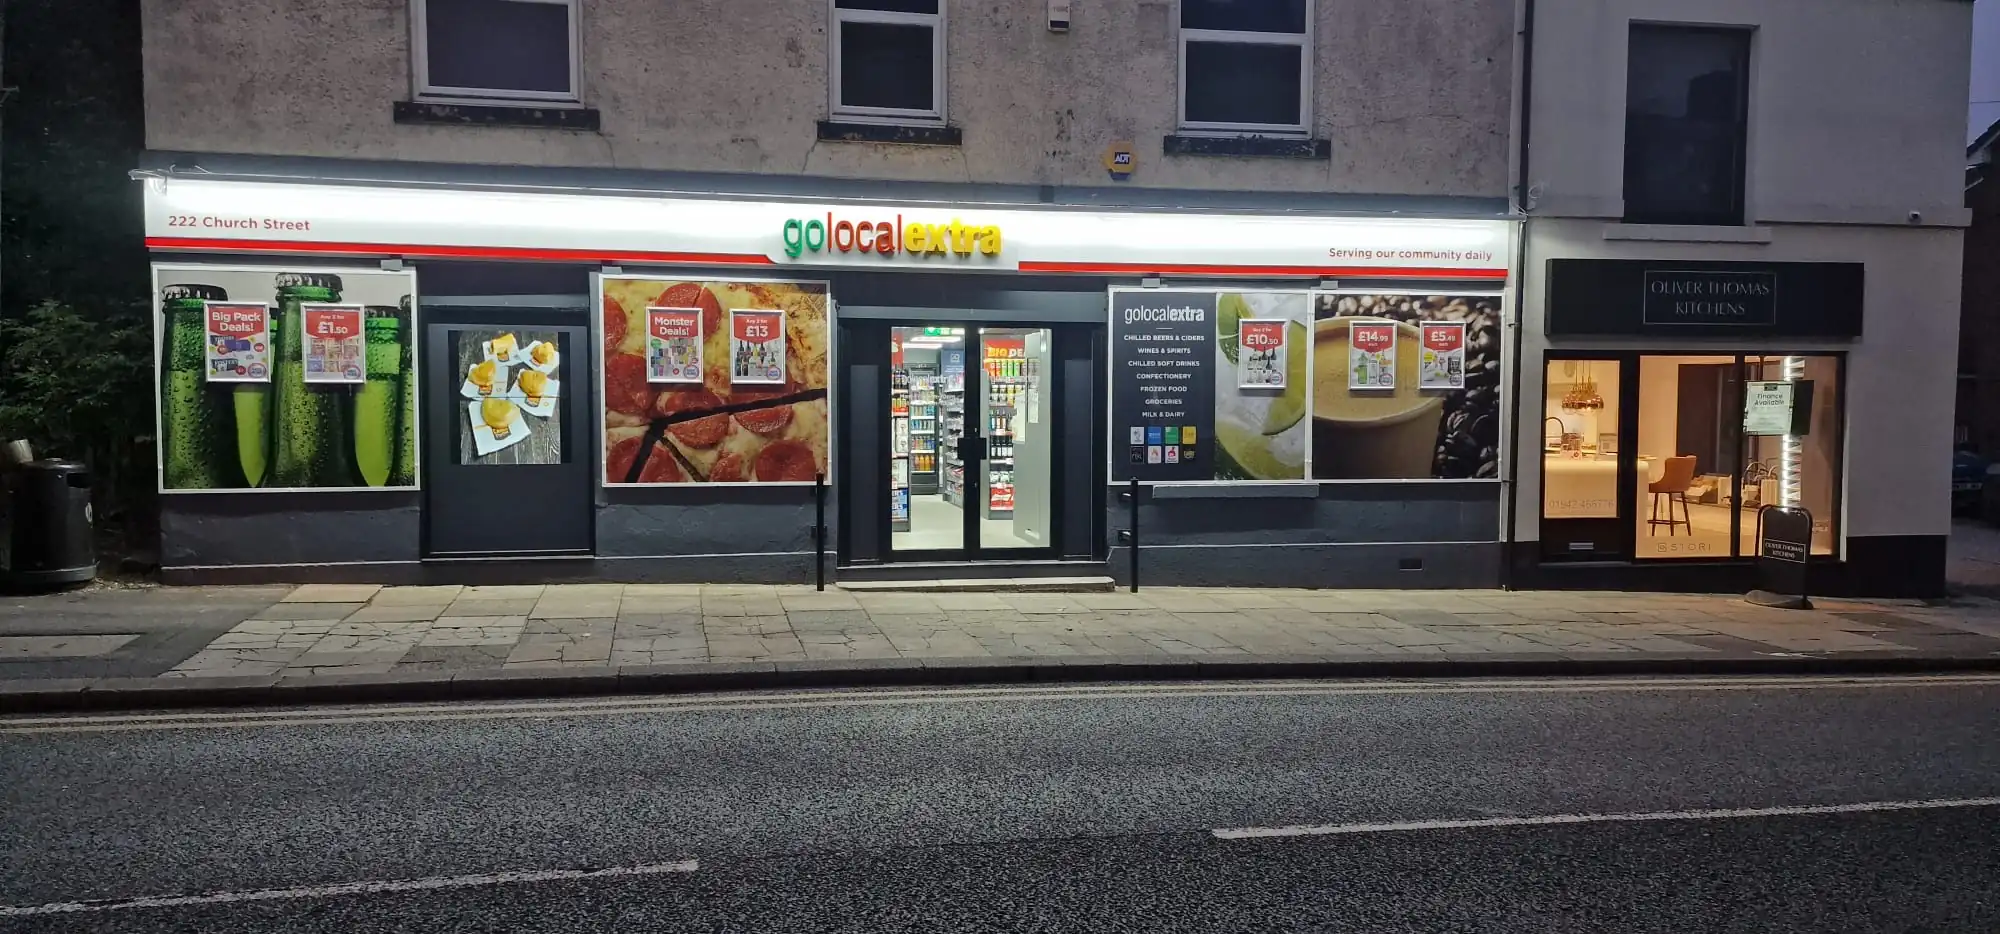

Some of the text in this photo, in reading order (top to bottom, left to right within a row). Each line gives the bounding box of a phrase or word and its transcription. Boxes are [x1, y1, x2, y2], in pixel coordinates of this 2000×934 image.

[1115, 154, 1129, 163] ADT
[168, 215, 310, 231] 222 Church Street
[783, 211, 1002, 258] golocalextra
[1329, 247, 1492, 262] Serving our community daily
[1651, 280, 1769, 295] OLIVER THOMAS
[1676, 301, 1745, 315] KITCHENS
[212, 311, 262, 322] Big Pack
[1124, 304, 1205, 325] golocalextra
[219, 322, 254, 332] Deals!
[318, 321, 348, 334] £1.50
[654, 316, 695, 327] Monster
[660, 326, 689, 336] Deals!
[746, 325, 768, 337] £13
[1358, 331, 1389, 342] £14.99
[1246, 333, 1279, 345] £10.50
